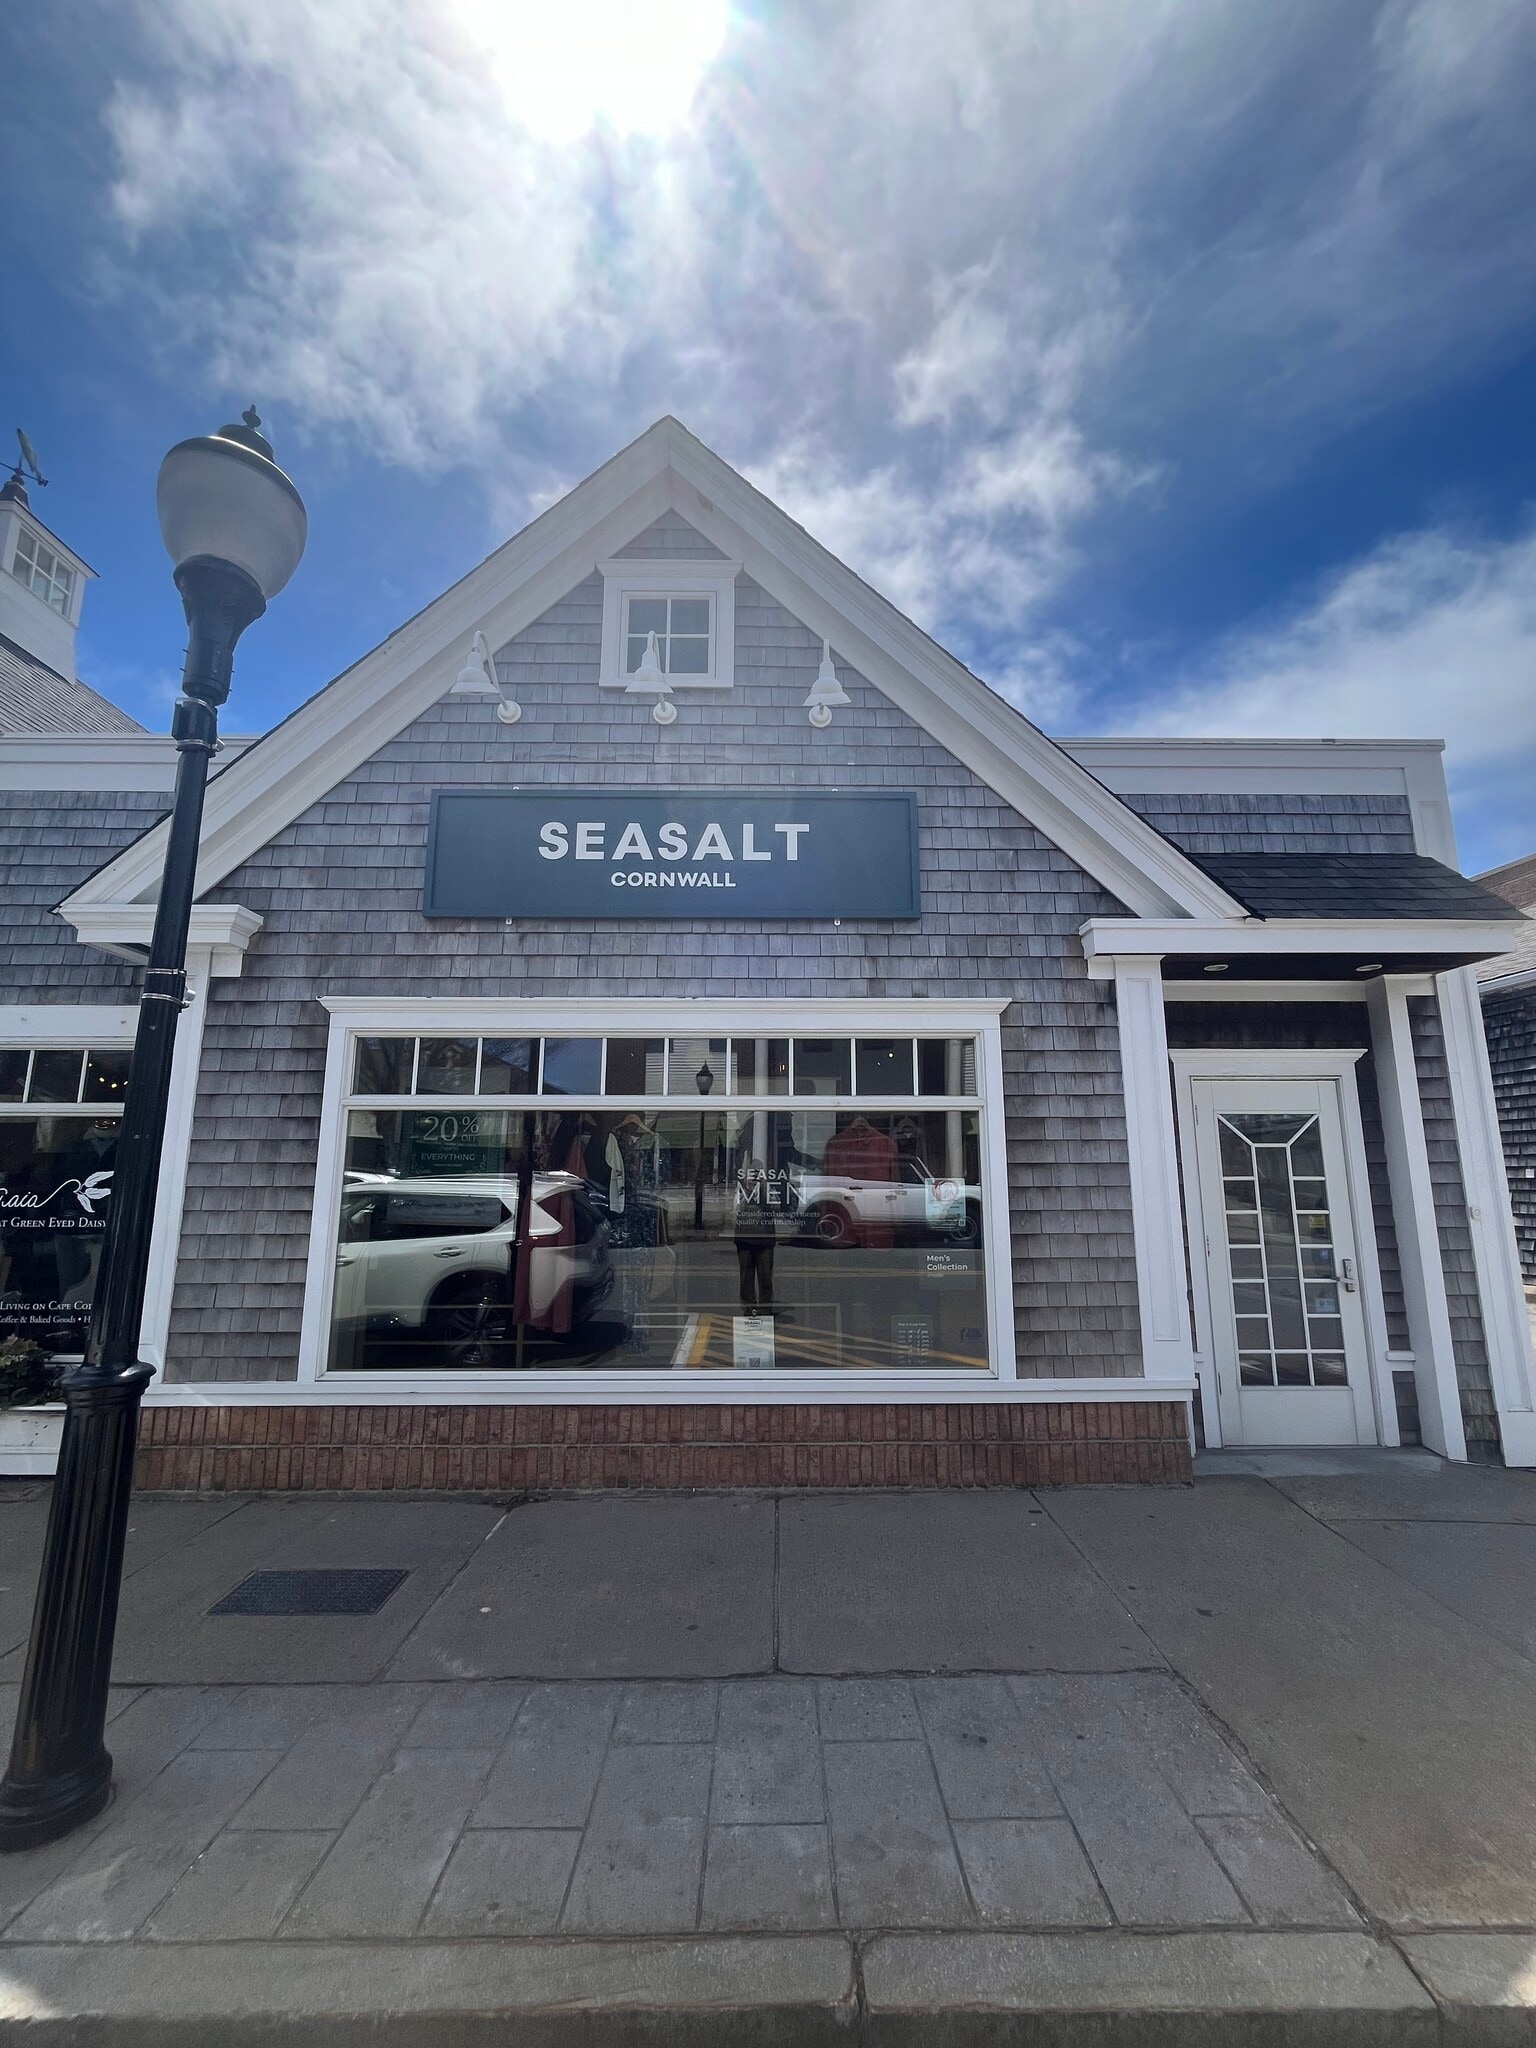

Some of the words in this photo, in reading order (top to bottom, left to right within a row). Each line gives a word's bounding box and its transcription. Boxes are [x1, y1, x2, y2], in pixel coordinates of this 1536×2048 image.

[538, 821, 810, 861] SEASALT
[610, 871, 737, 887] CORNWALL
[421, 1153, 476, 1161] EVERYTHING
[737, 1168, 807, 1180] SEASALT
[736, 1181, 807, 1205] MEN
[926, 1254, 951, 1262] Men's
[926, 1263, 968, 1271] Collection
[20, 1315, 28, 1323] &
[29, 1315, 51, 1323] Baked
[52, 1315, 76, 1323] Goods
